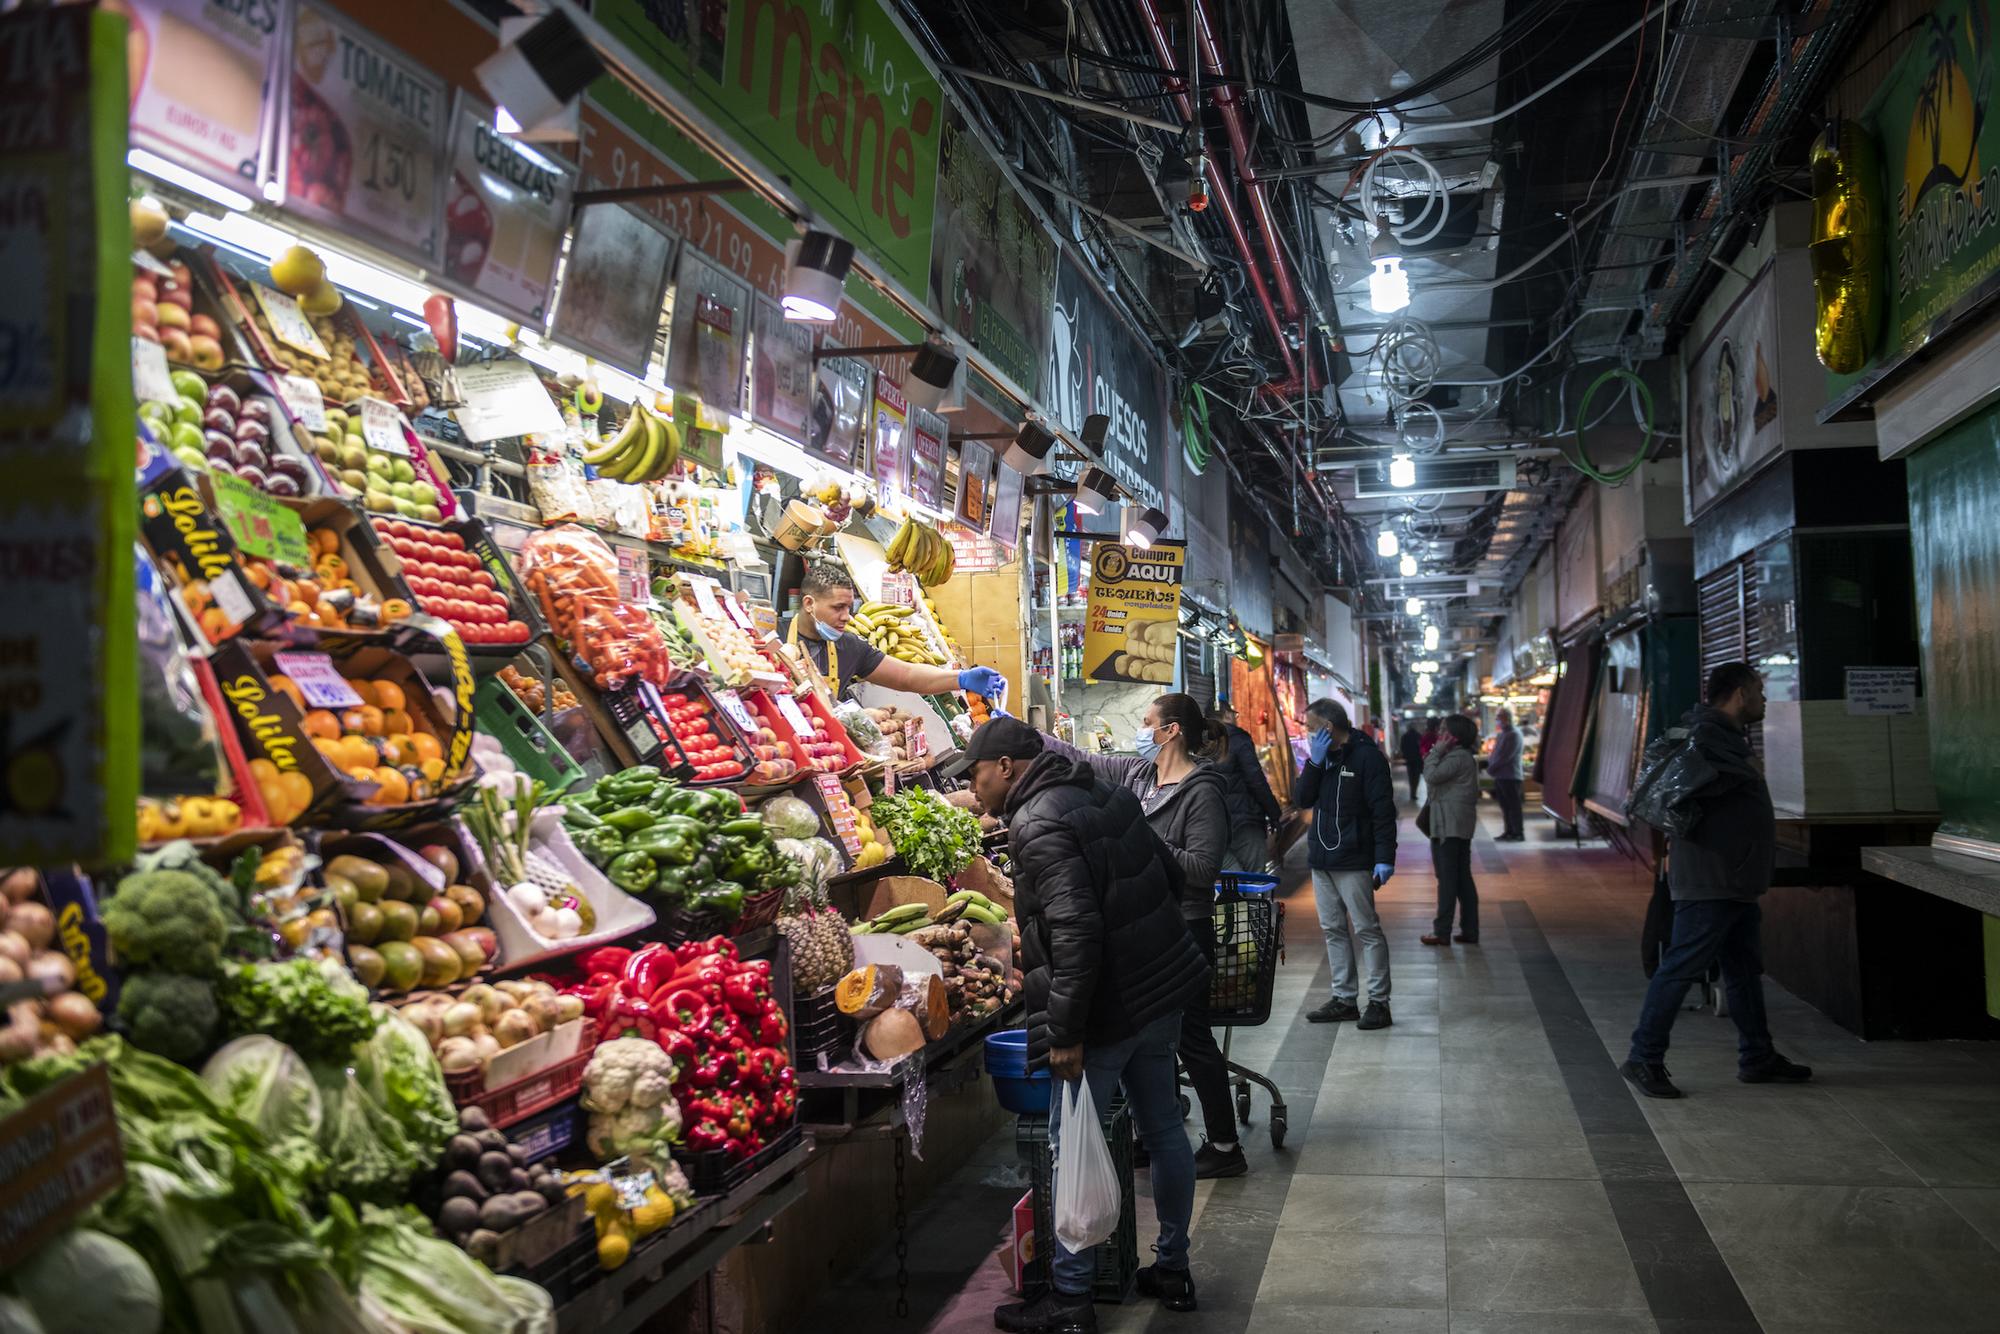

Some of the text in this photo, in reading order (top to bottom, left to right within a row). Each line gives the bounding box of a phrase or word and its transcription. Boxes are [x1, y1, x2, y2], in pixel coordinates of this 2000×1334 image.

[339, 36, 432, 128] TOMATE
[474, 126, 558, 205] CEREZAS
[980, 302, 989, 339] la
[878, 377, 906, 412] OFERTA
[1095, 375, 1148, 465] QUESOS
[1104, 450, 1164, 513] UERRERO
[1131, 547, 1176, 562] Compra
[1092, 605, 1107, 618] 24
[1092, 619, 1104, 633] 12
[221, 674, 300, 771] Lolita
